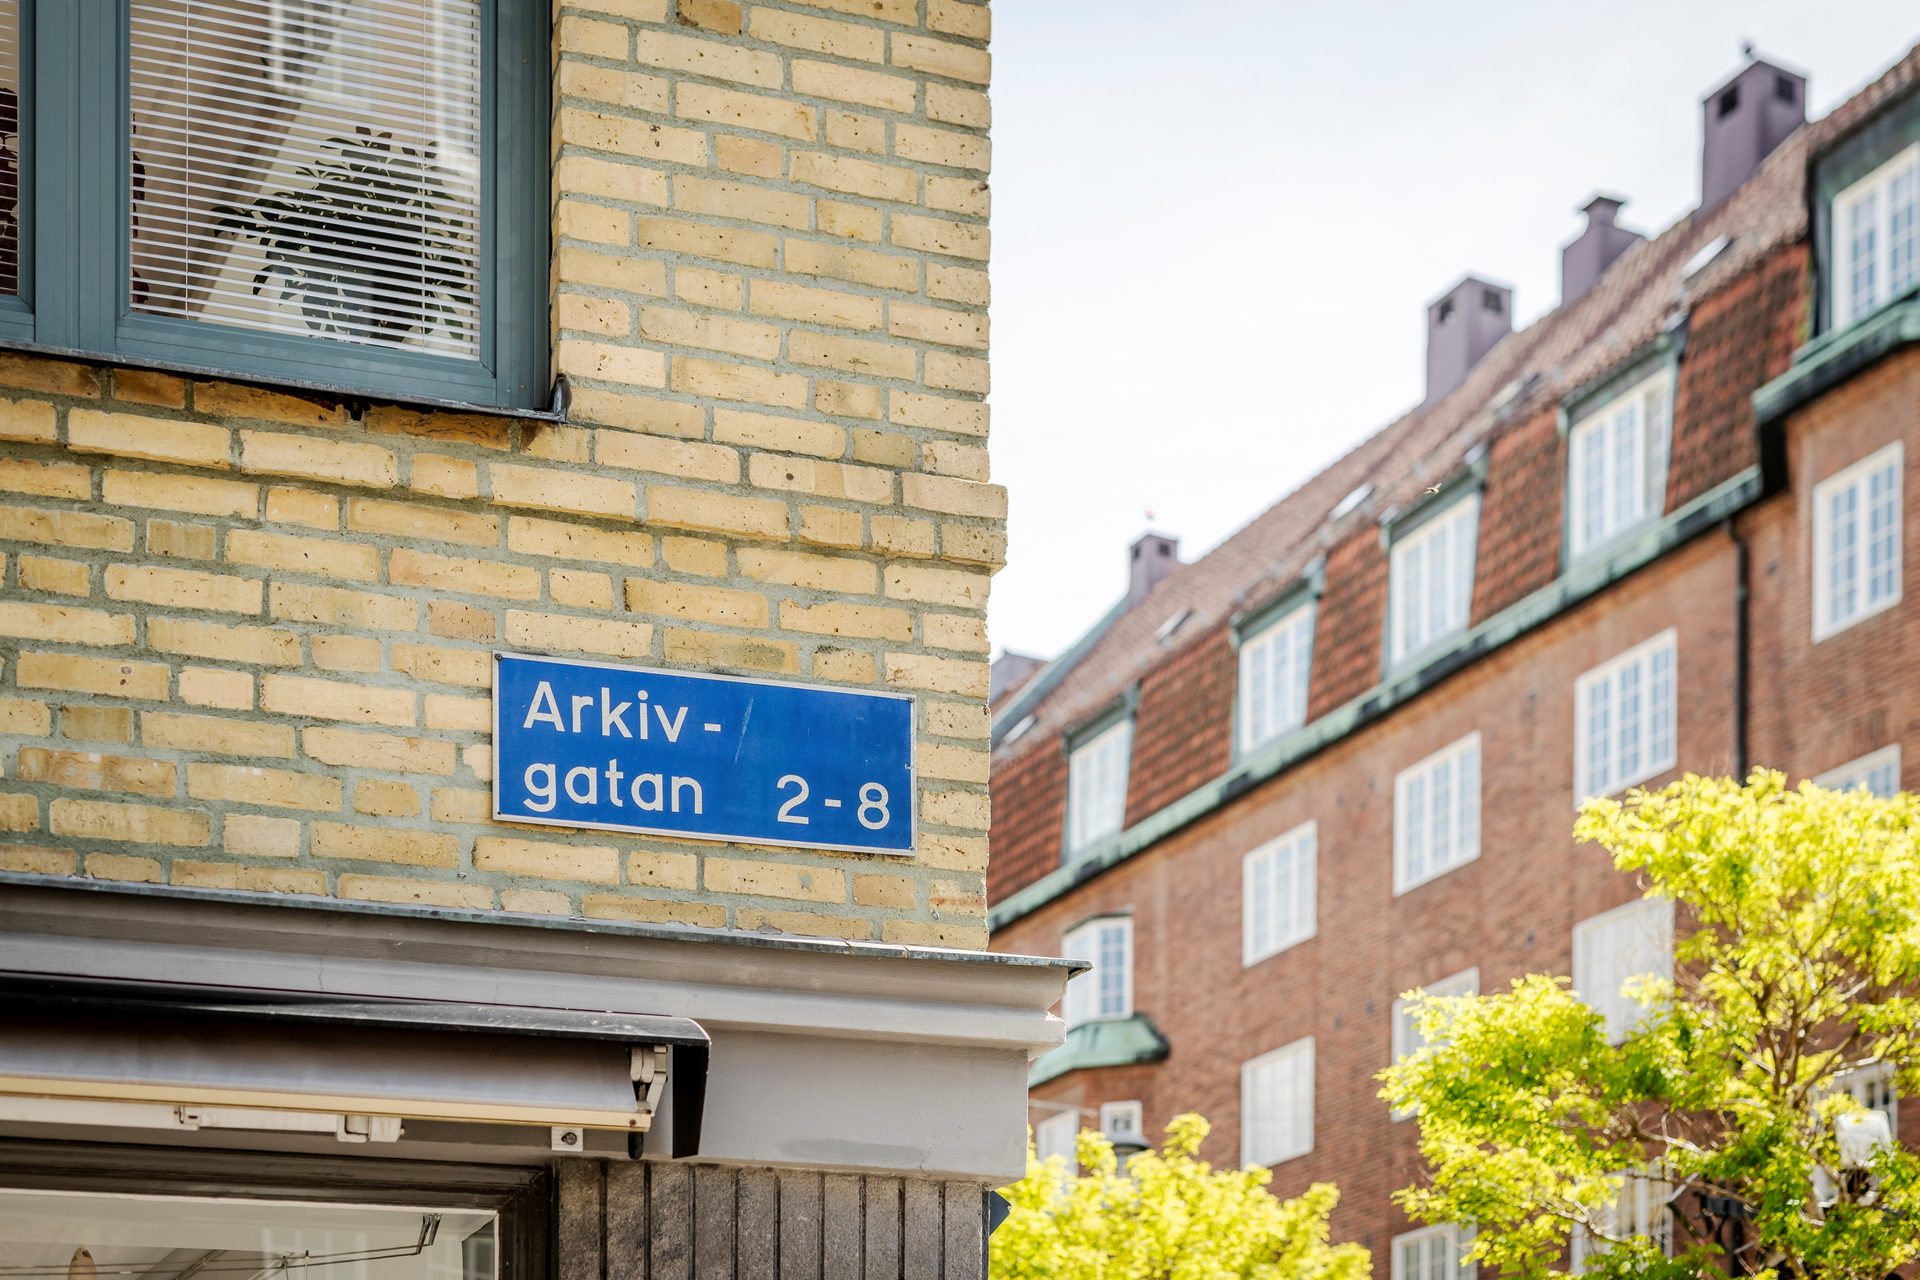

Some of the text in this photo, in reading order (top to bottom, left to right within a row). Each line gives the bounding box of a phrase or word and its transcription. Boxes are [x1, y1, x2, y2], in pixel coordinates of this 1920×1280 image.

[522, 680, 721, 743] Arkiv-
[522, 758, 890, 830] gatan 2-8
